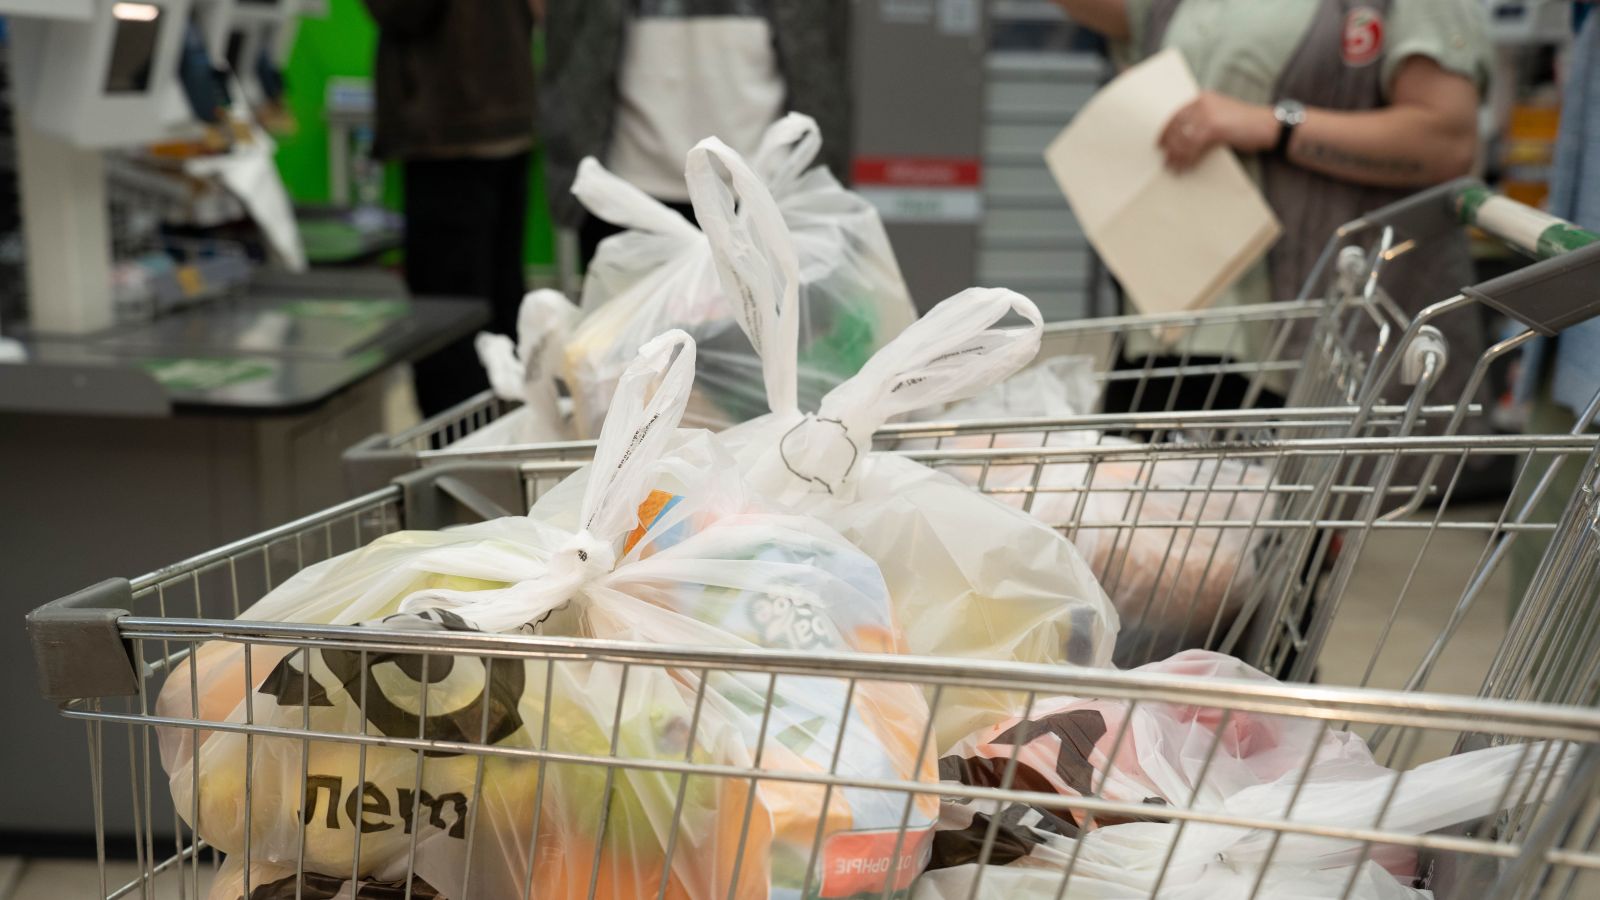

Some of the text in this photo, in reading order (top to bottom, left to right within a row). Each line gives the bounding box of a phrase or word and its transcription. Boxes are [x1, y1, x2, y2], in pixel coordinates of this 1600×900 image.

[1345, 16, 1374, 55] 5
[297, 774, 468, 840] лет
[834, 855, 913, 876] ОТОРНЫЕ
